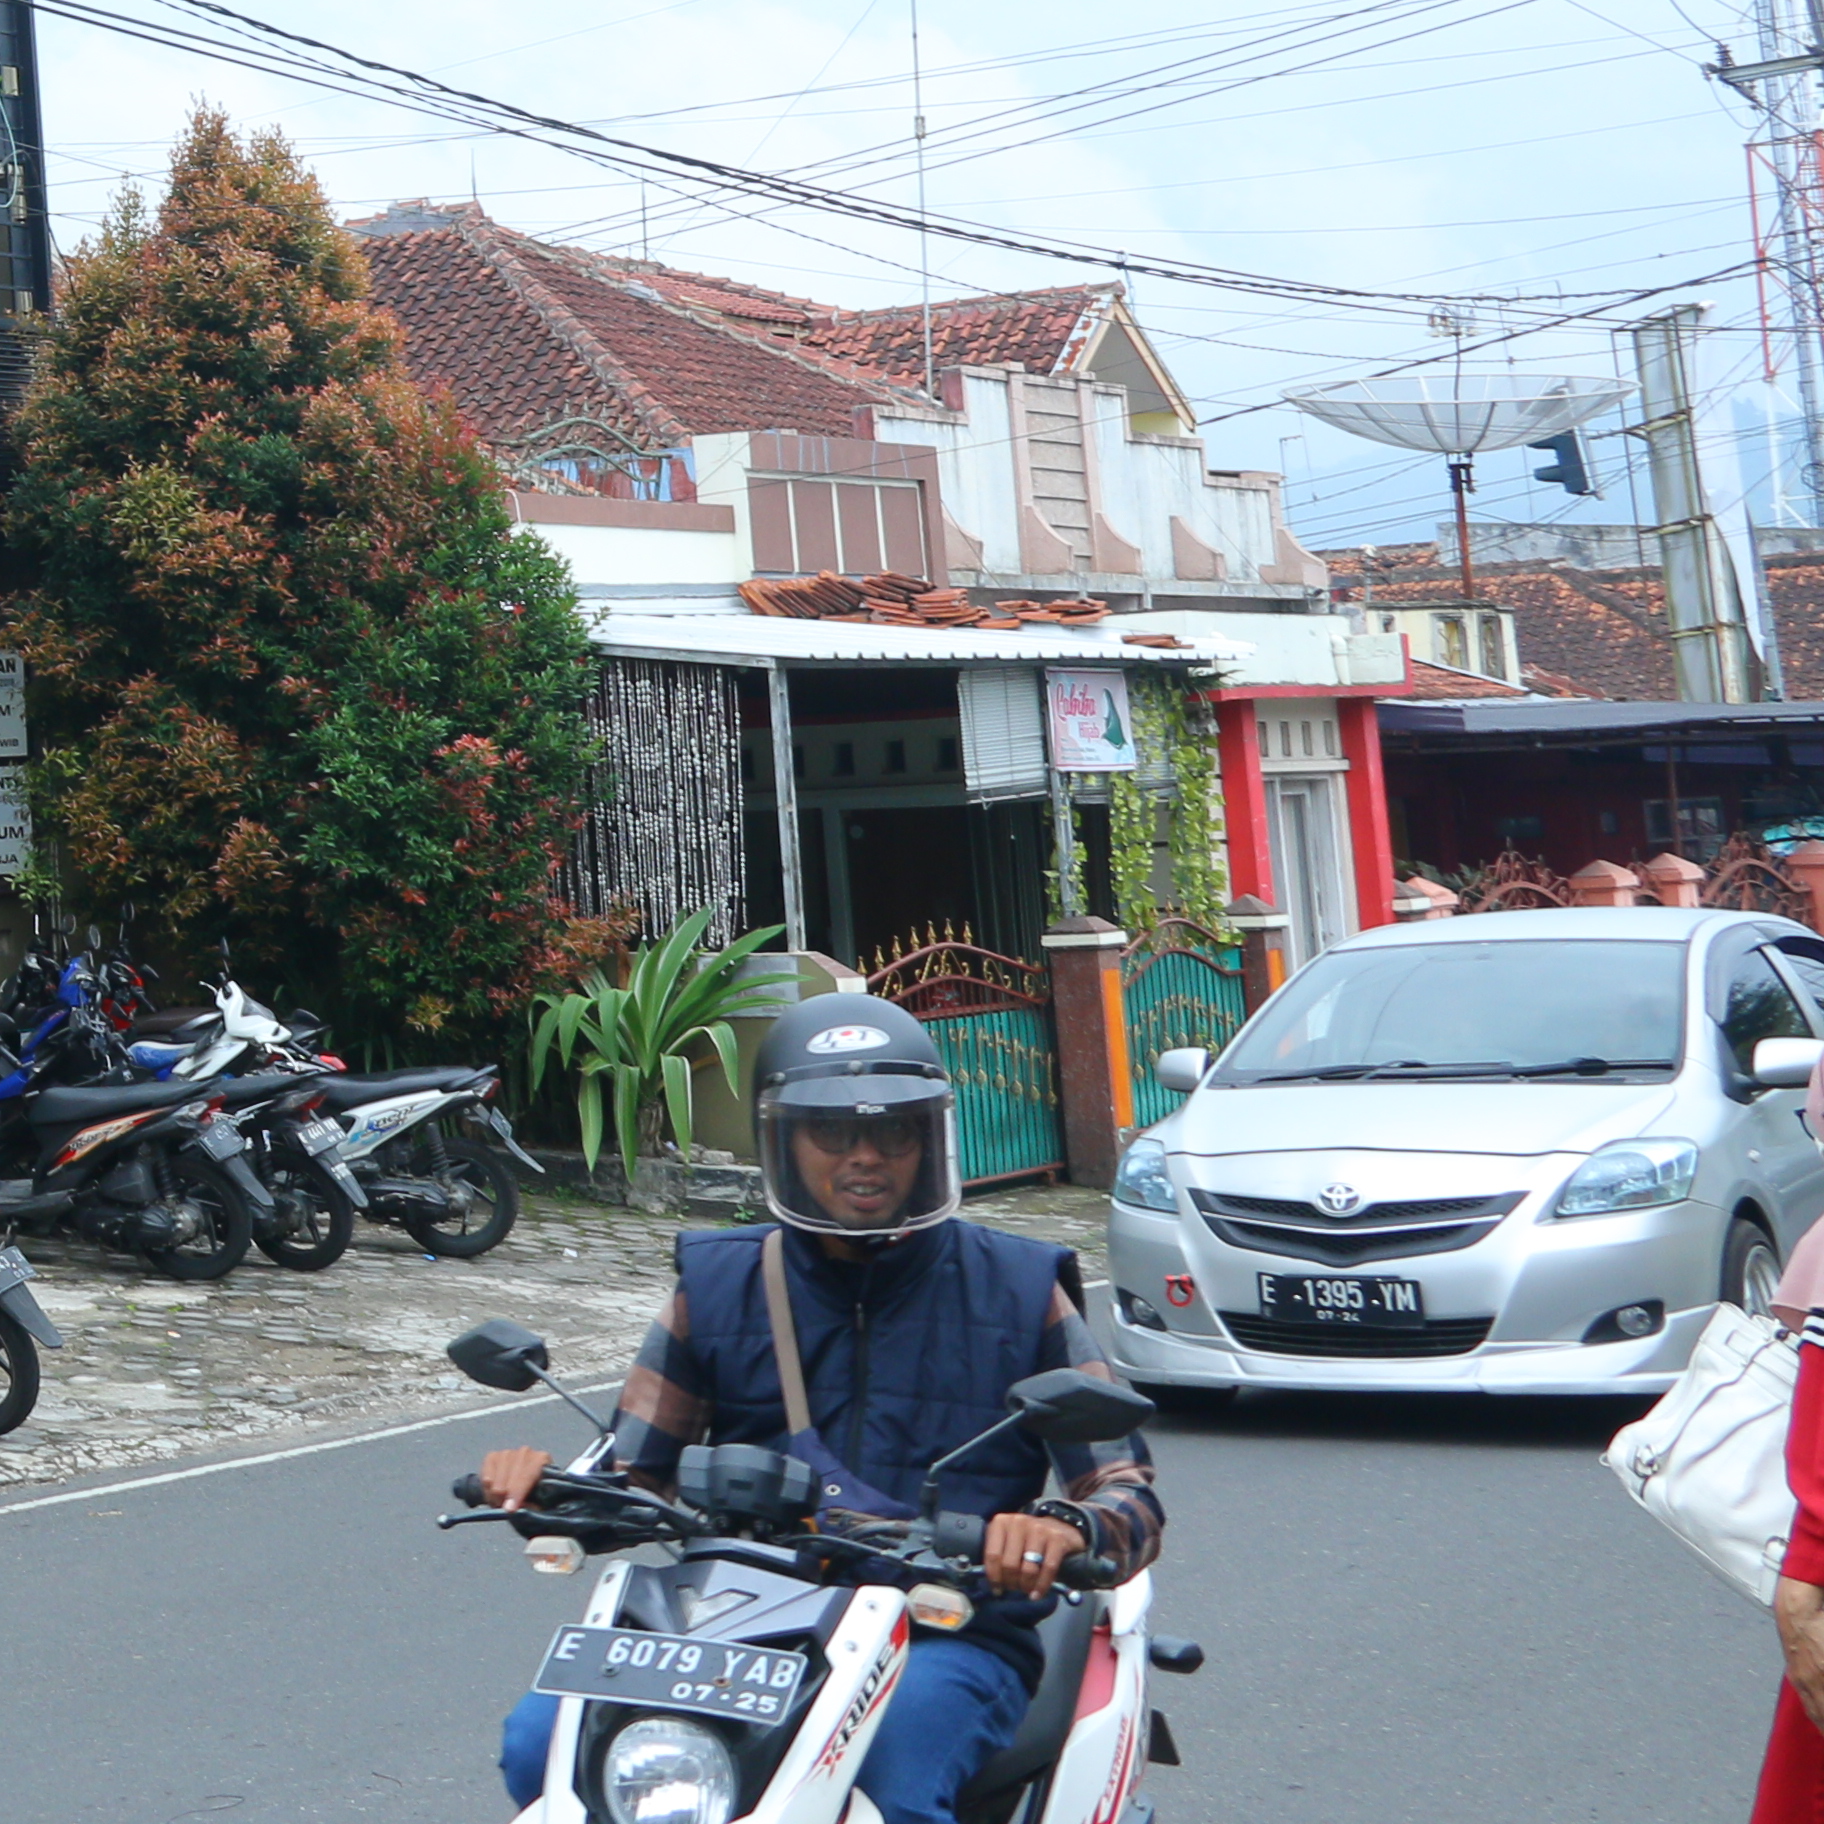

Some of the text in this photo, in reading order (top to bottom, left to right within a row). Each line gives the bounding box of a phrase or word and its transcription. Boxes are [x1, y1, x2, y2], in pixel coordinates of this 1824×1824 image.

[0, 738, 19, 747] WIB
[1260, 1275, 1417, 1311] E 1395 YM
[553, 1632, 798, 1688] E 6079 YAB
